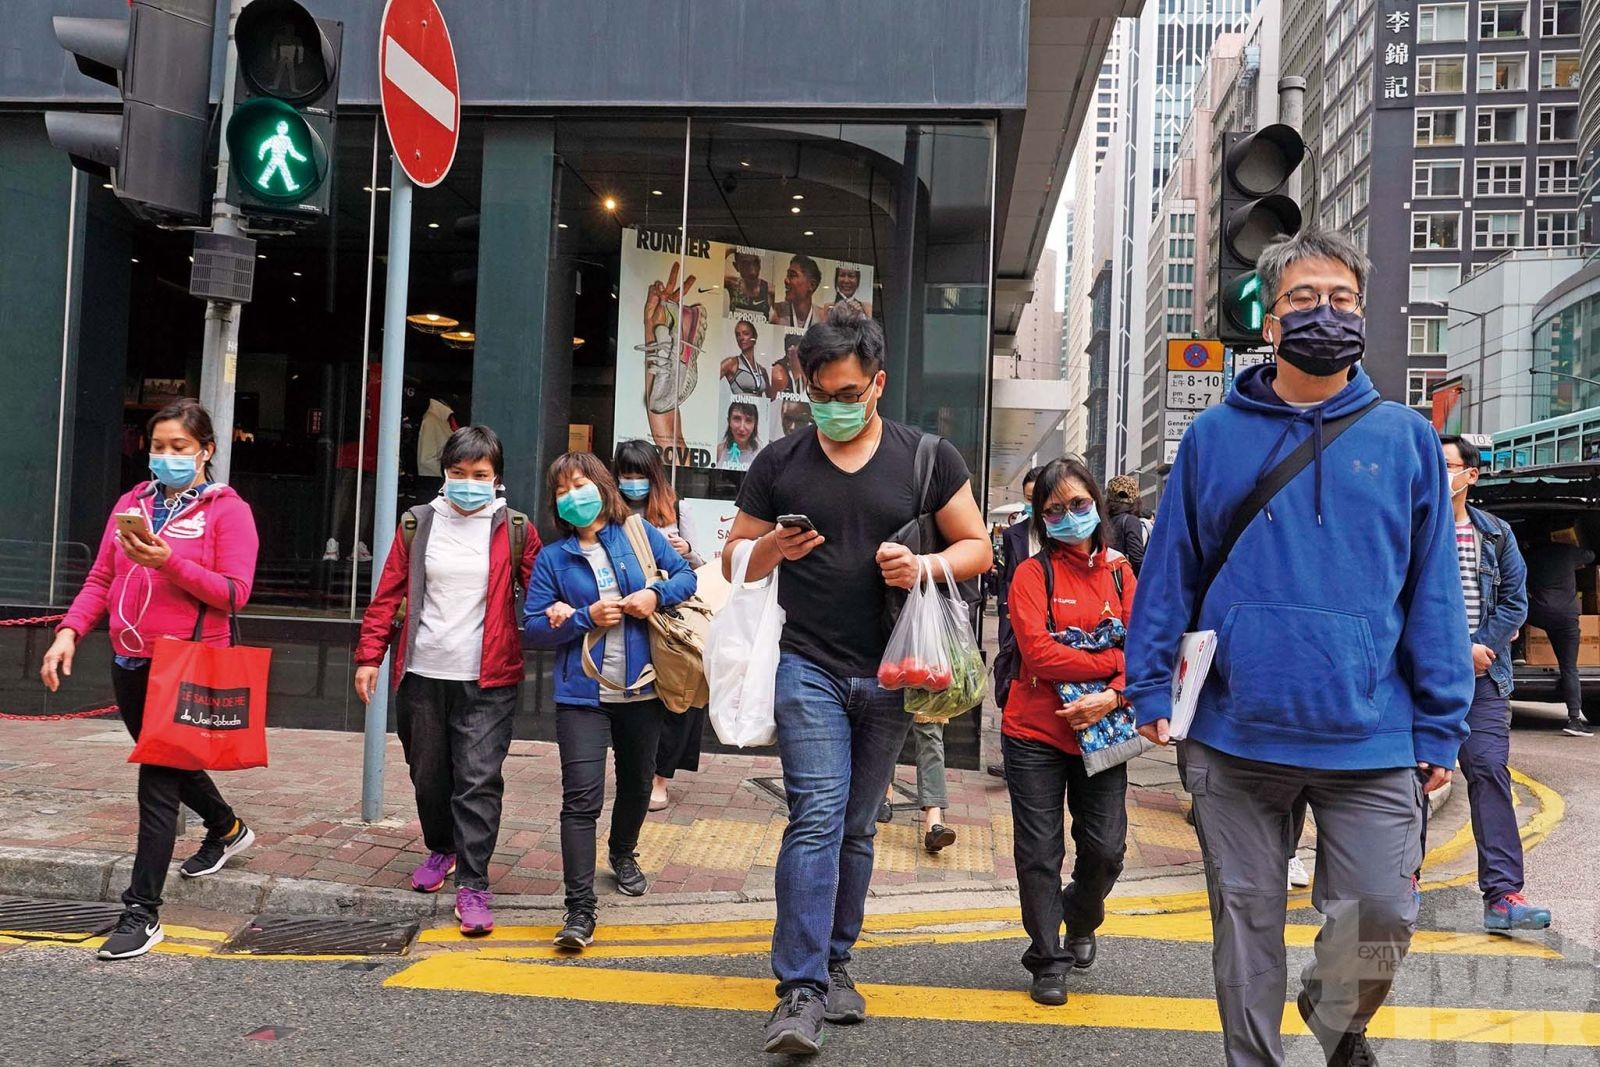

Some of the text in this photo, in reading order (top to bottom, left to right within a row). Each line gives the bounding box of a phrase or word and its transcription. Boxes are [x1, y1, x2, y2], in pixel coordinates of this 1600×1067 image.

[1384, 10, 1410, 99] 李錦記
[1240, 356, 1261, 366] 上午
[1171, 398, 1184, 406] 下午
